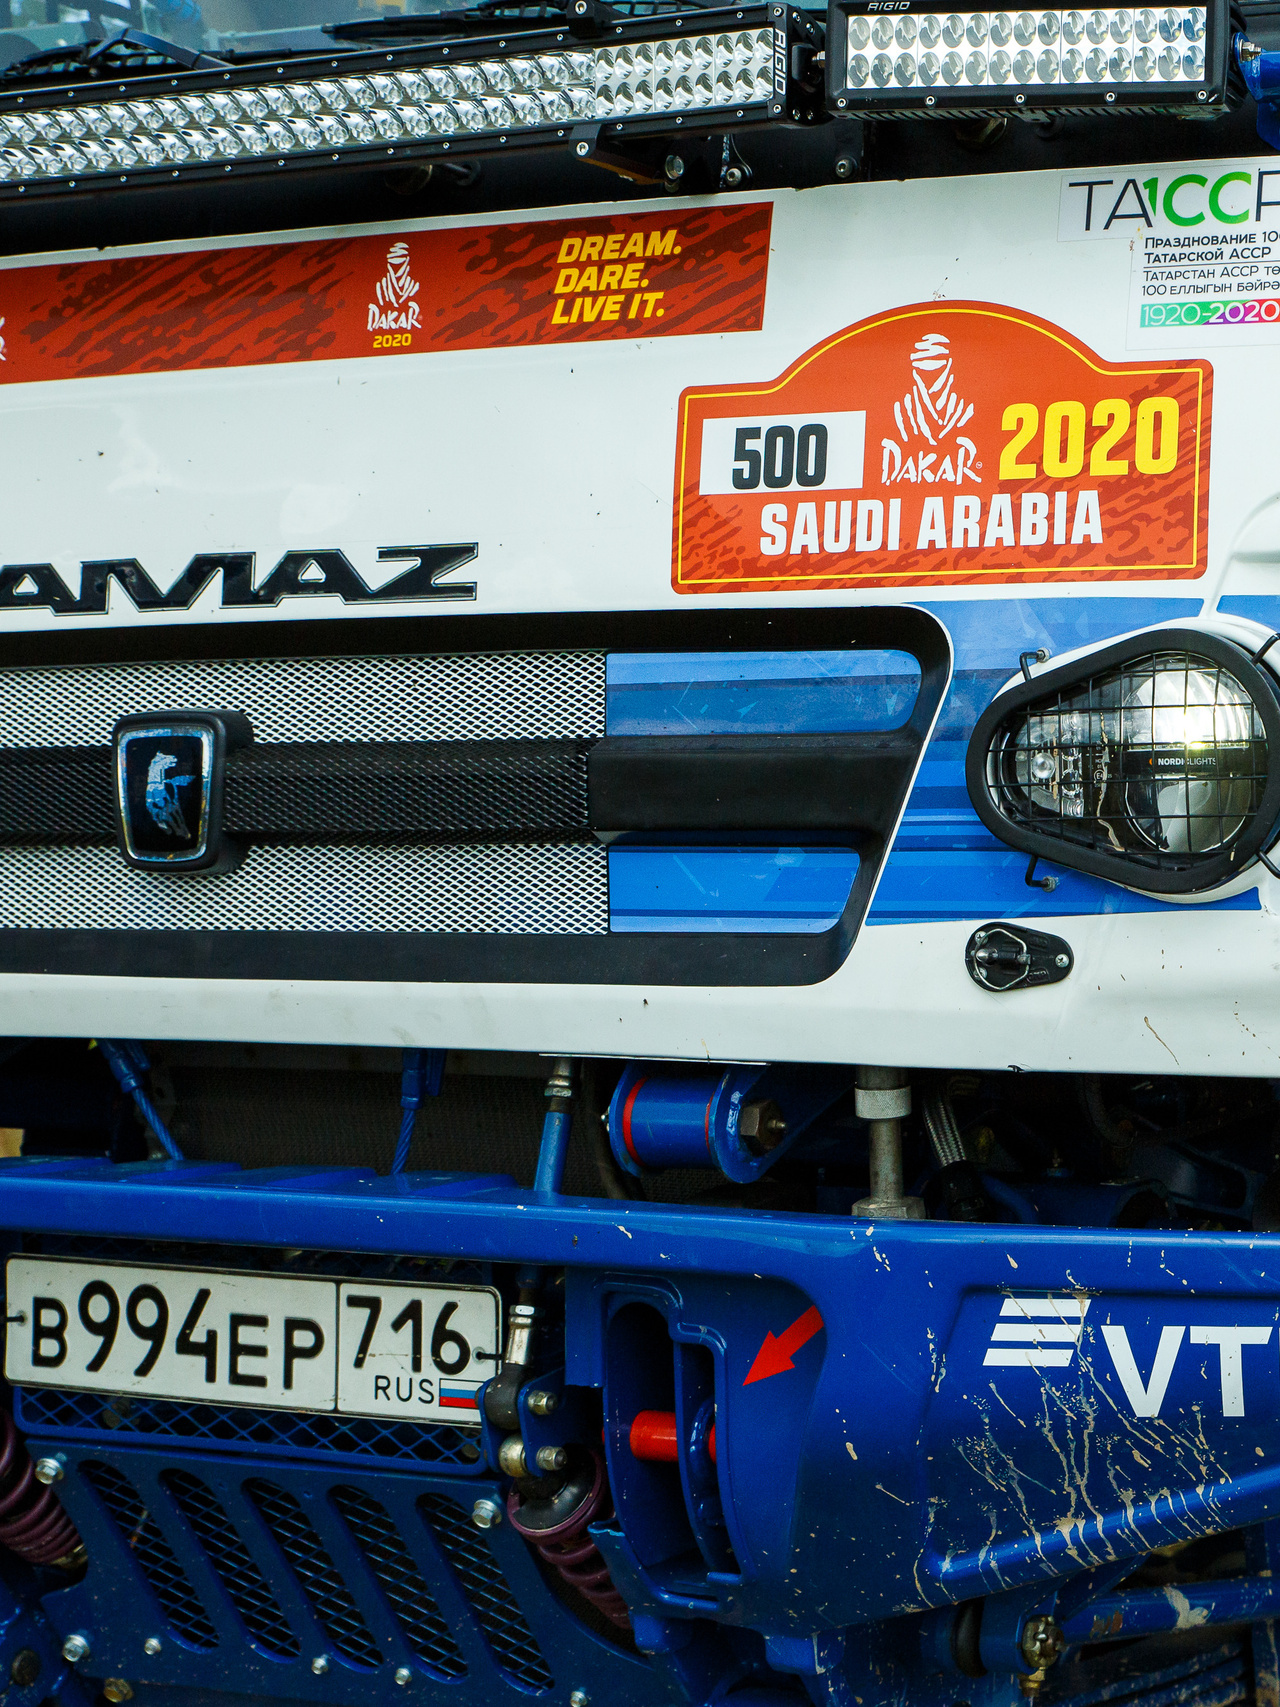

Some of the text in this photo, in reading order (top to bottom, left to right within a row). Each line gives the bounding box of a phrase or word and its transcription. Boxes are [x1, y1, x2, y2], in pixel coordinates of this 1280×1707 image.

[867, 1, 911, 12] RIGID
[774, 28, 787, 96] RIGID
[556, 229, 683, 263] DREAM.
[1144, 246, 1272, 265] ТАТАРСКОЙ АССР
[553, 262, 650, 294] DARE.
[1143, 268, 1216, 282] ТАТАРСТАН
[1219, 265, 1259, 278] АССР
[1141, 285, 1167, 297] 100
[367, 301, 422, 332] DAKAR
[551, 291, 665, 325] LIVE IT.
[1143, 301, 1280, 327] 1920-2020
[372, 332, 412, 349] 2020
[731, 395, 1180, 491] 500 DAKAR 2020
[759, 488, 1103, 557] SAUDI ARABIA
[345, 1295, 471, 1376] 716
[373, 1375, 435, 1405] RUS
